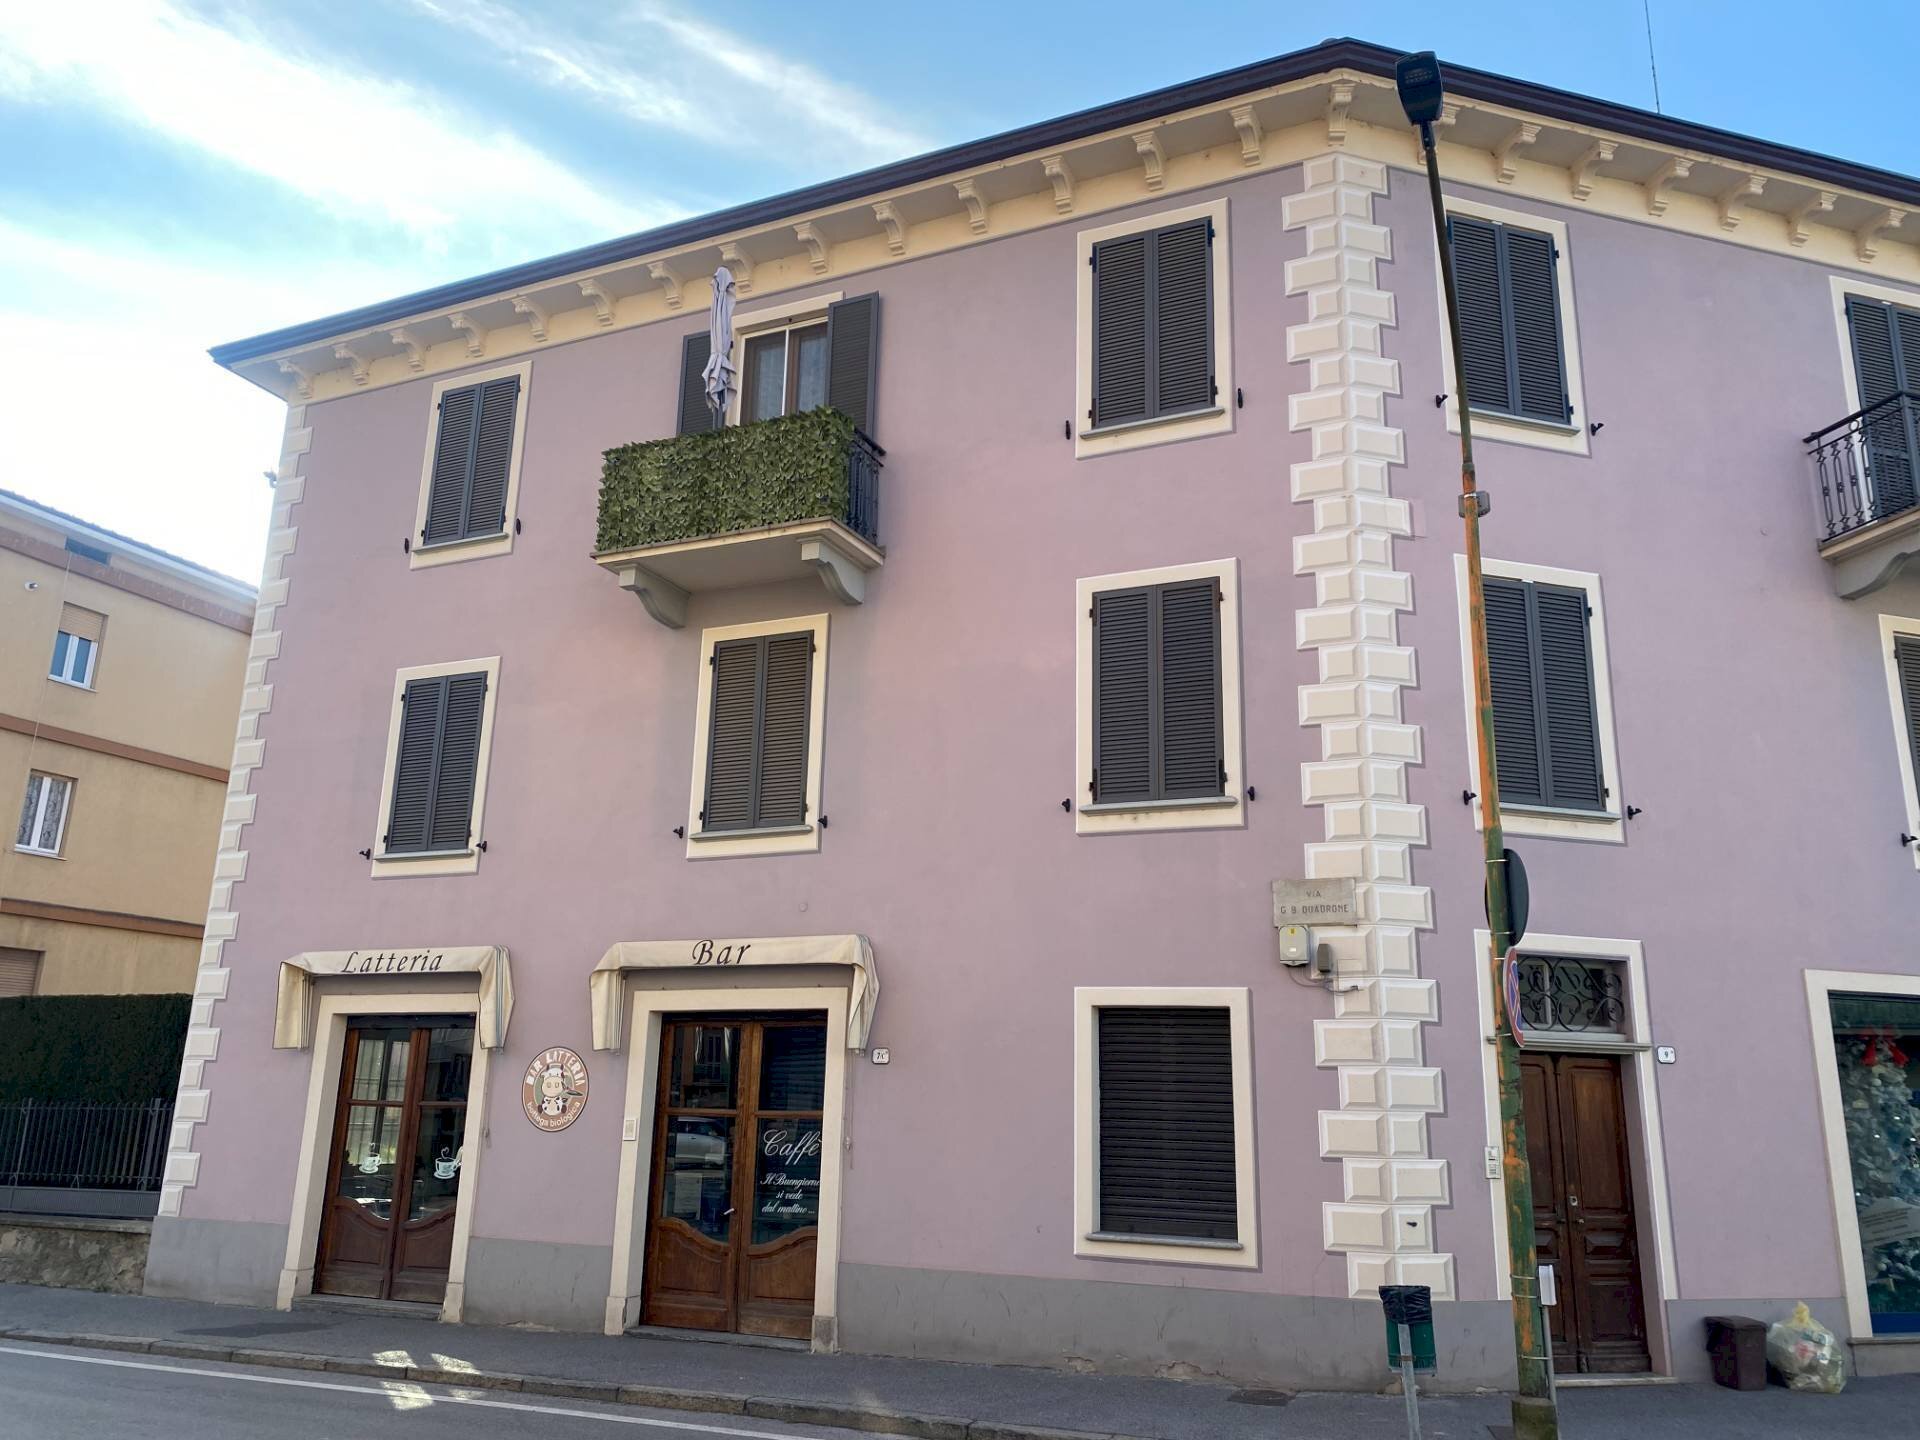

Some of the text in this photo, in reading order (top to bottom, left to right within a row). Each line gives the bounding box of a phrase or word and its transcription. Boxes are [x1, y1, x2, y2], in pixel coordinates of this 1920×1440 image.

[1302, 904, 1349, 914] QUADRONE
[341, 949, 443, 973] Latteria
[692, 939, 751, 965] Bar
[526, 1050, 586, 1086] BAR LATTERIA
[527, 1101, 581, 1127] bottega biologica
[763, 1129, 822, 1166] Caffè
[761, 1200, 780, 1213] dal
[785, 1188, 803, 1200] vede
